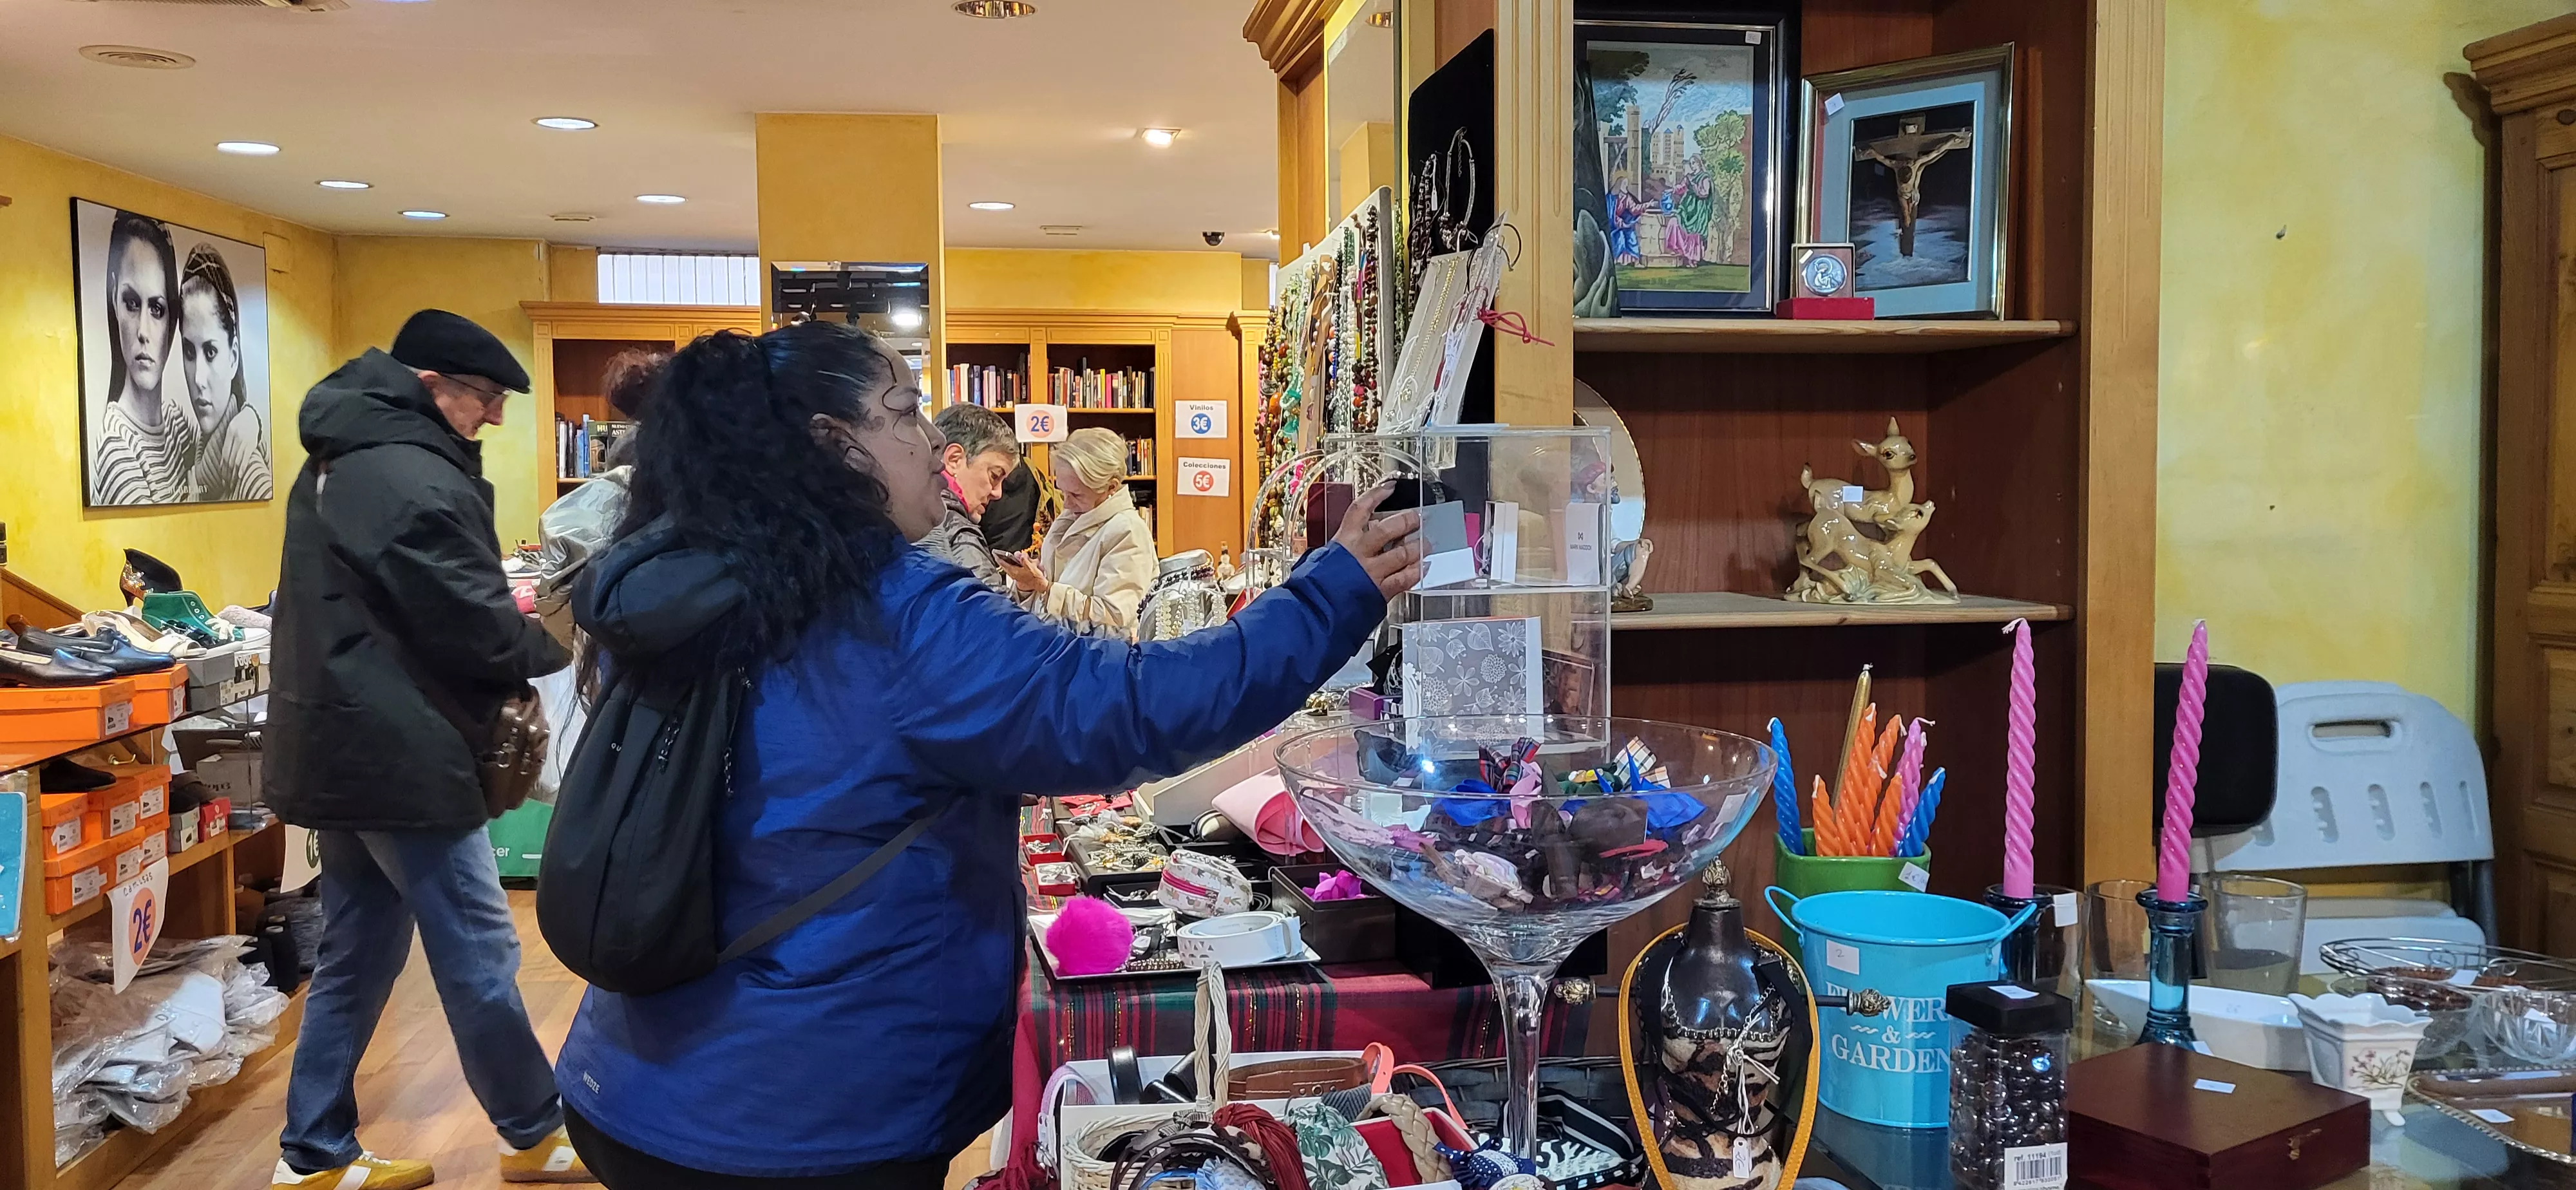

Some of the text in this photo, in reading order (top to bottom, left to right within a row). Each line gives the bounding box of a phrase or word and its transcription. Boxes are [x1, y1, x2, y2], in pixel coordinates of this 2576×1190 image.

[1030, 415, 1050, 432] 2€
[1193, 417, 1208, 430] 3€
[1195, 474, 1210, 488] 5€
[308, 829, 319, 861] 1€
[133, 899, 152, 954] 2€
[1835, 949, 1844, 958] 2
[1881, 1025, 1900, 1044] &
[1832, 1034, 1951, 1073] GARDEN
[583, 1071, 600, 1094] WEDZE
